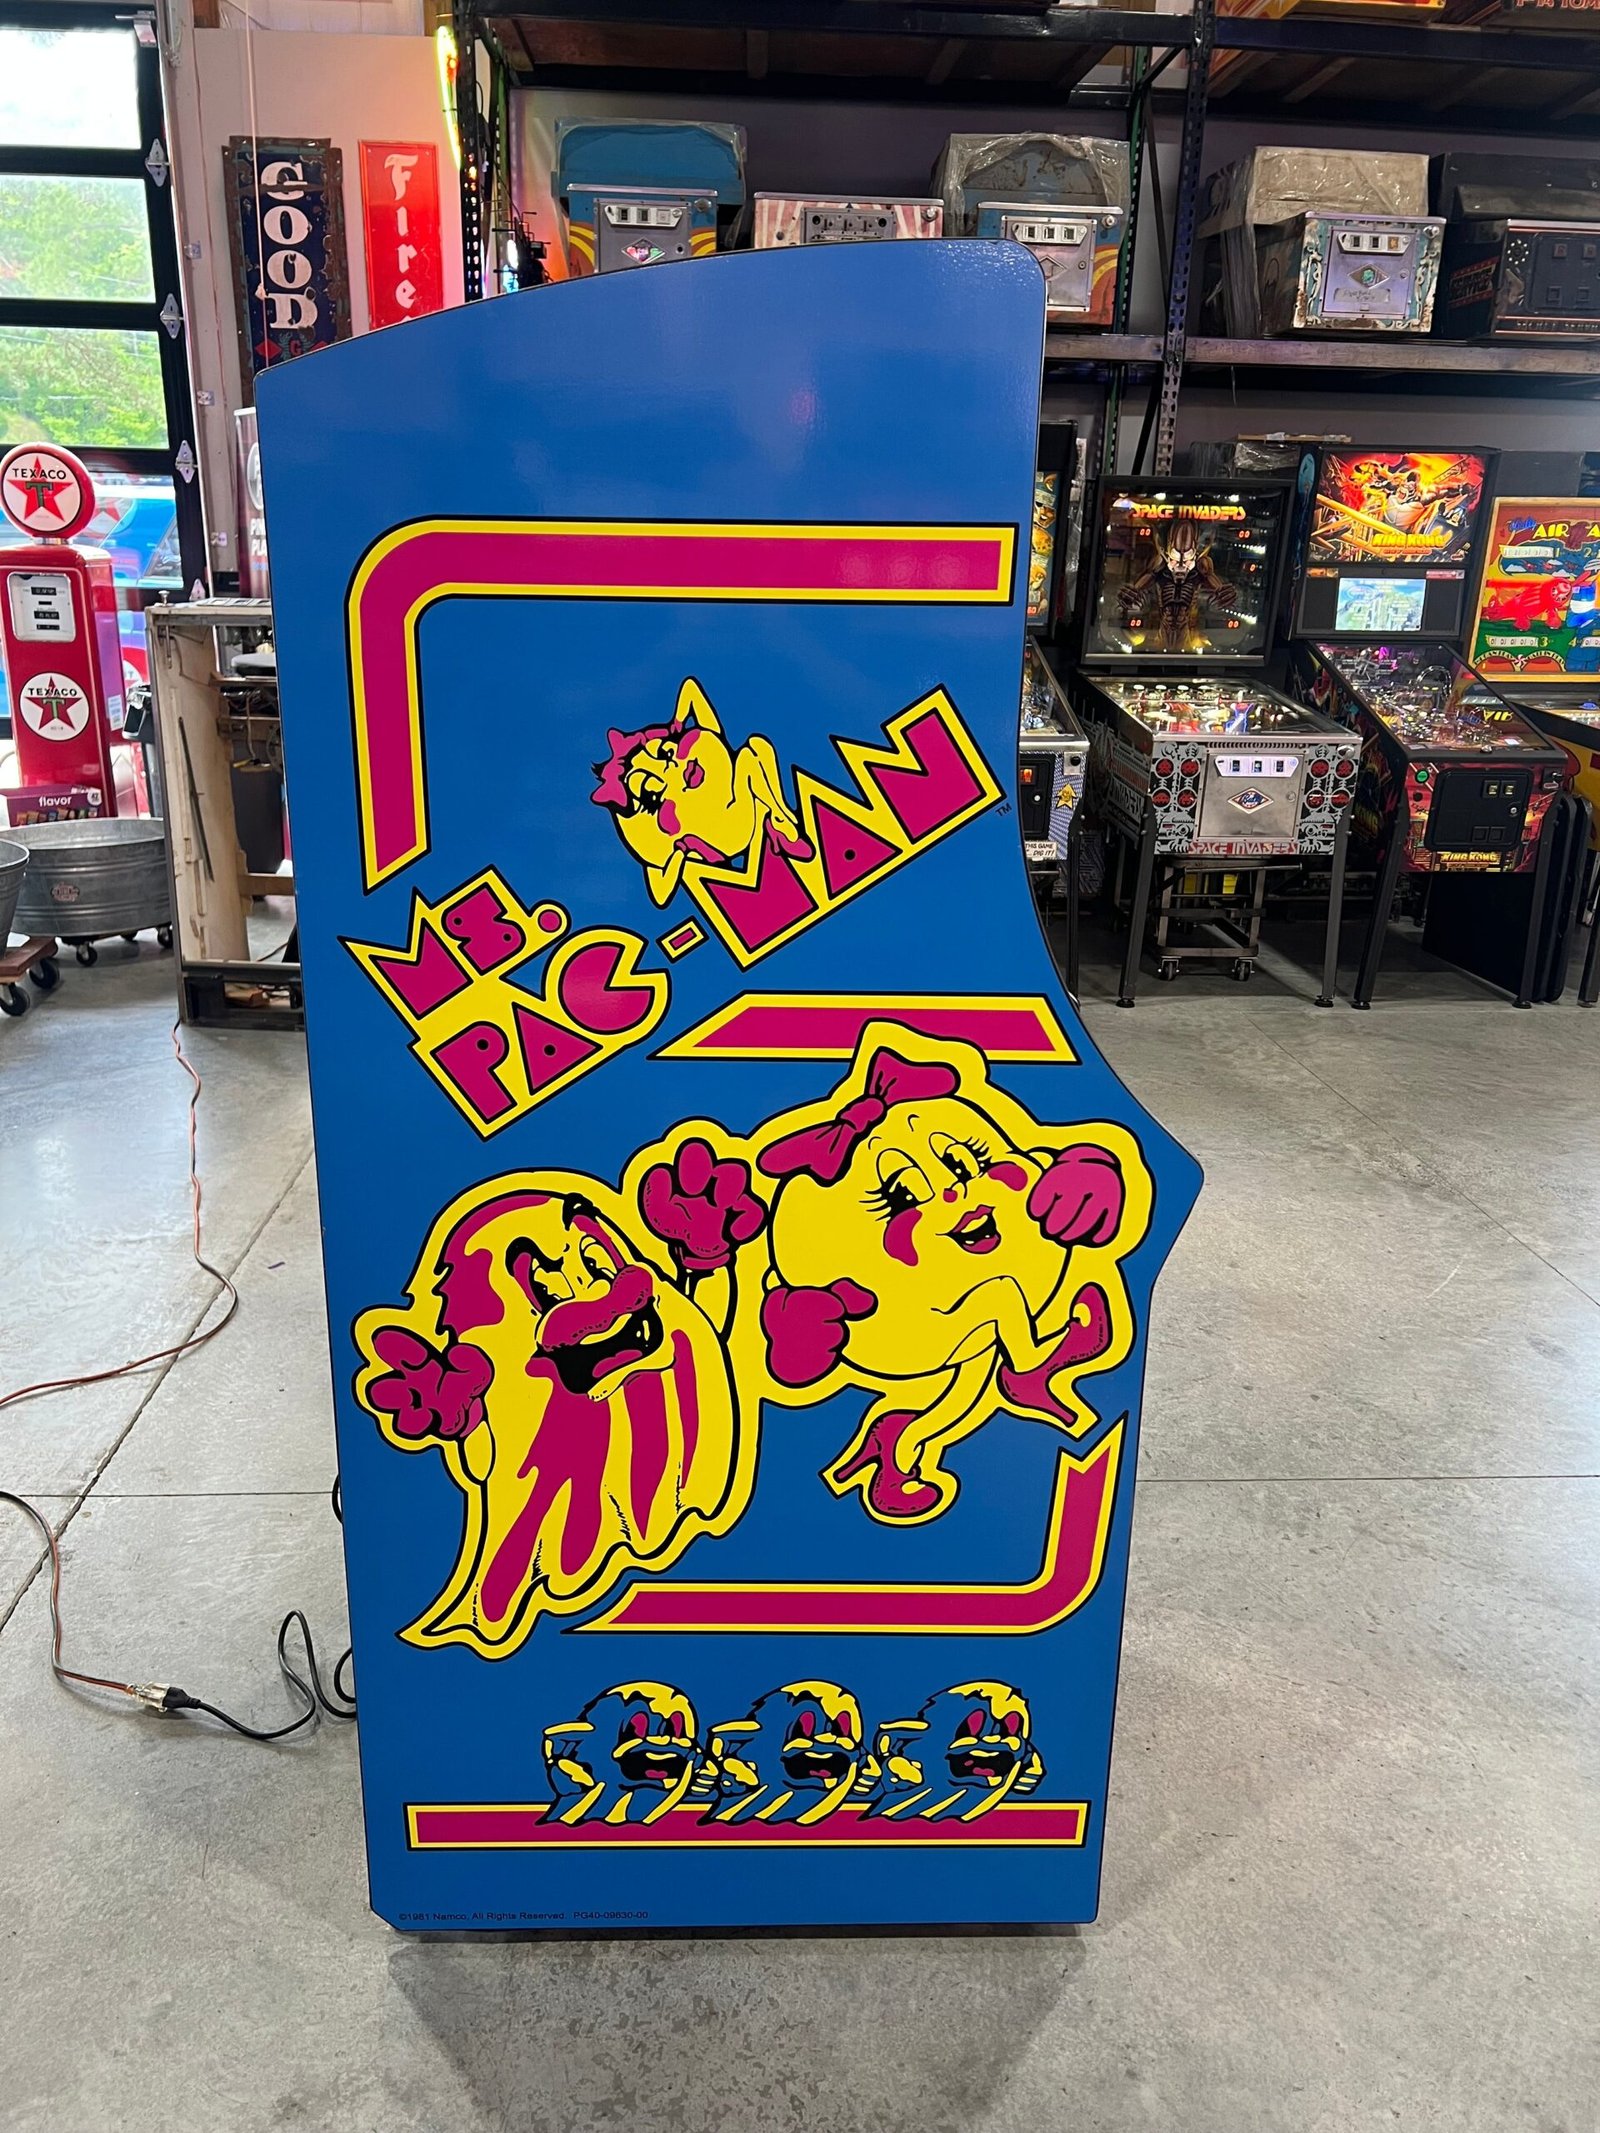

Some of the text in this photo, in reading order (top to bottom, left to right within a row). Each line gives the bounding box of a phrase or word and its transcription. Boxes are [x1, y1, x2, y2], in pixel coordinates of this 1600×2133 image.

[384, 153, 419, 321] Fire
[260, 161, 318, 330] GOOD
[12, 467, 67, 480] TEXACO
[1131, 503, 1247, 520] SPACE INVADERS
[1532, 523, 1570, 539] AIR
[1372, 533, 1445, 547] KING KONG
[28, 687, 78, 697] TEXACO
[38, 795, 72, 807] flavor
[995, 803, 1013, 817] TM
[1188, 842, 1298, 855] SPACE INVADERS
[1442, 852, 1497, 861] KING KONG
[338, 865, 571, 1040] MS.
[487, 1911, 517, 1921] Rights
